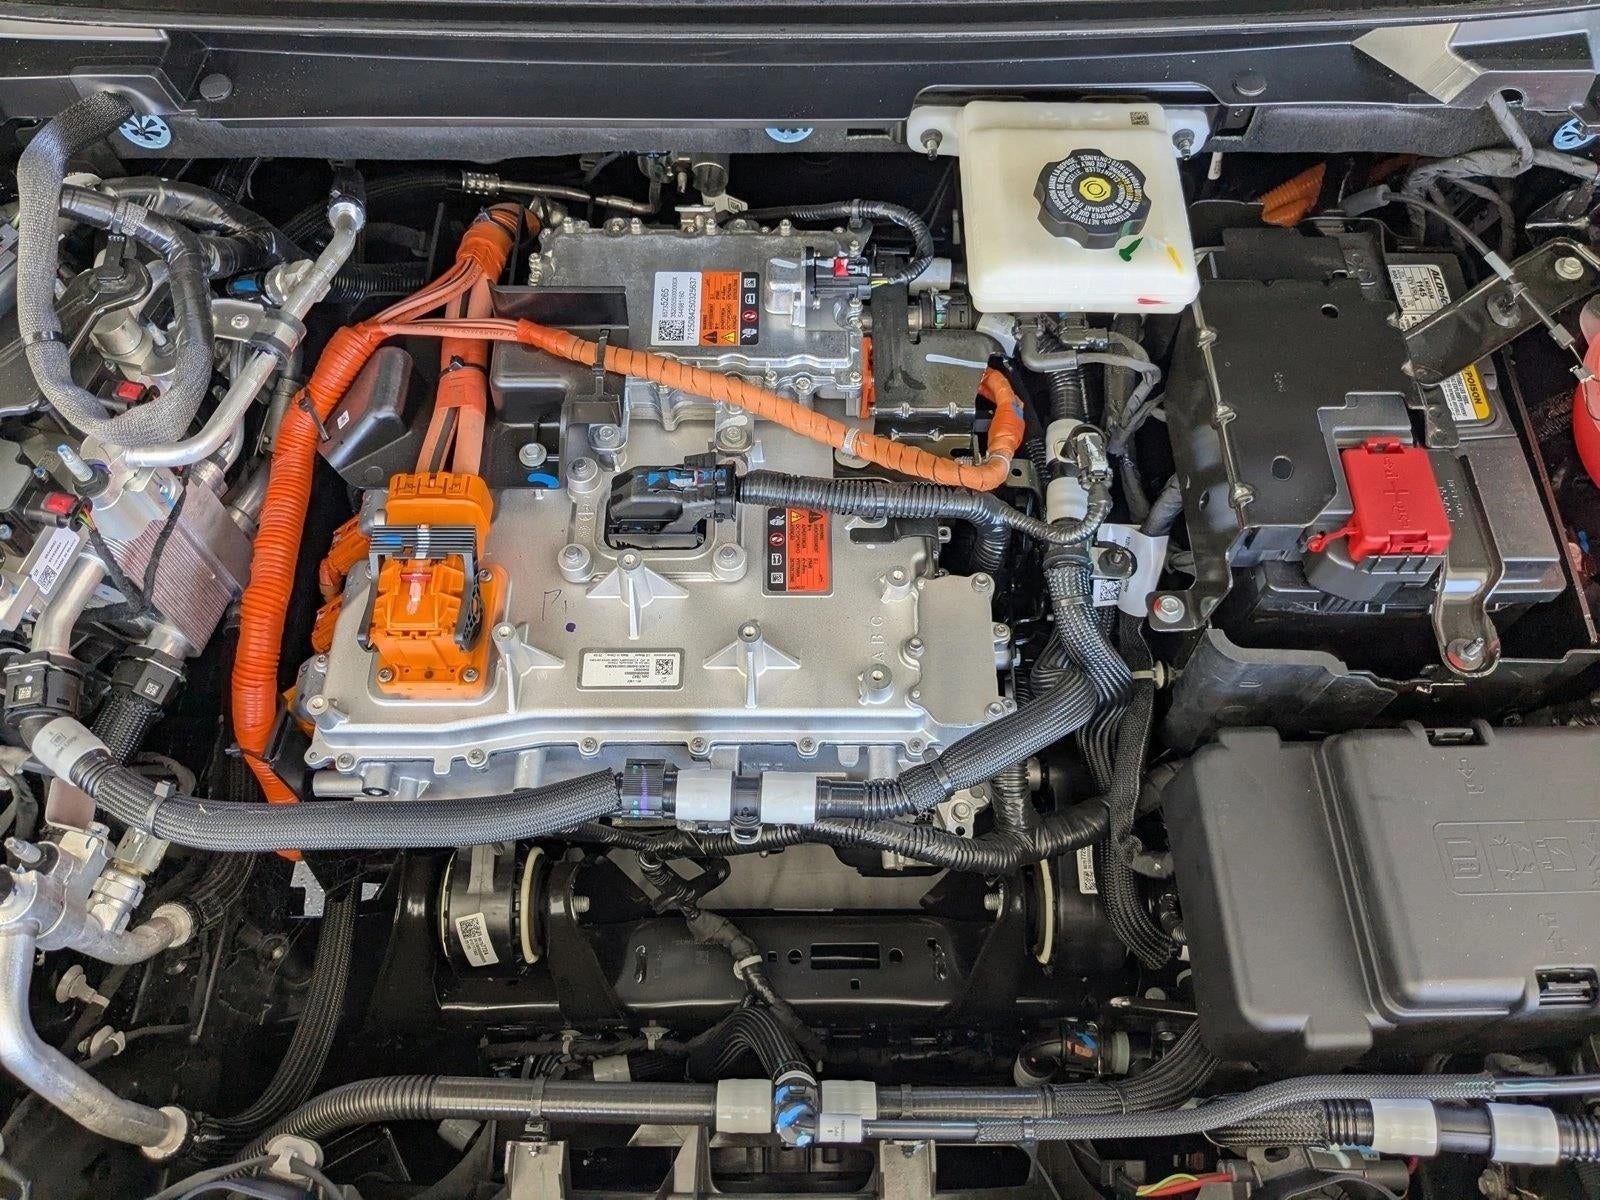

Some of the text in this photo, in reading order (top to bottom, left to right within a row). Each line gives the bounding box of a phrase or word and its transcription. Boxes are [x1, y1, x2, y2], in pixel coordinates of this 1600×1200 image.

[1079, 159, 1094, 168] ONLY
[1110, 159, 1131, 174] SEALED
[1051, 168, 1062, 176] LA
[1103, 168, 1122, 182] CLEAN
[1068, 204, 1078, 212] DU
[1076, 208, 1090, 217] QUE
[1082, 201, 1117, 213] PROVENANT
[1068, 212, 1099, 224] NETTOYER
[1431, 270, 1449, 306] ACDelc
[1466, 372, 1483, 404] POISON
[871, 617, 882, 626] C
[872, 634, 884, 644] B
